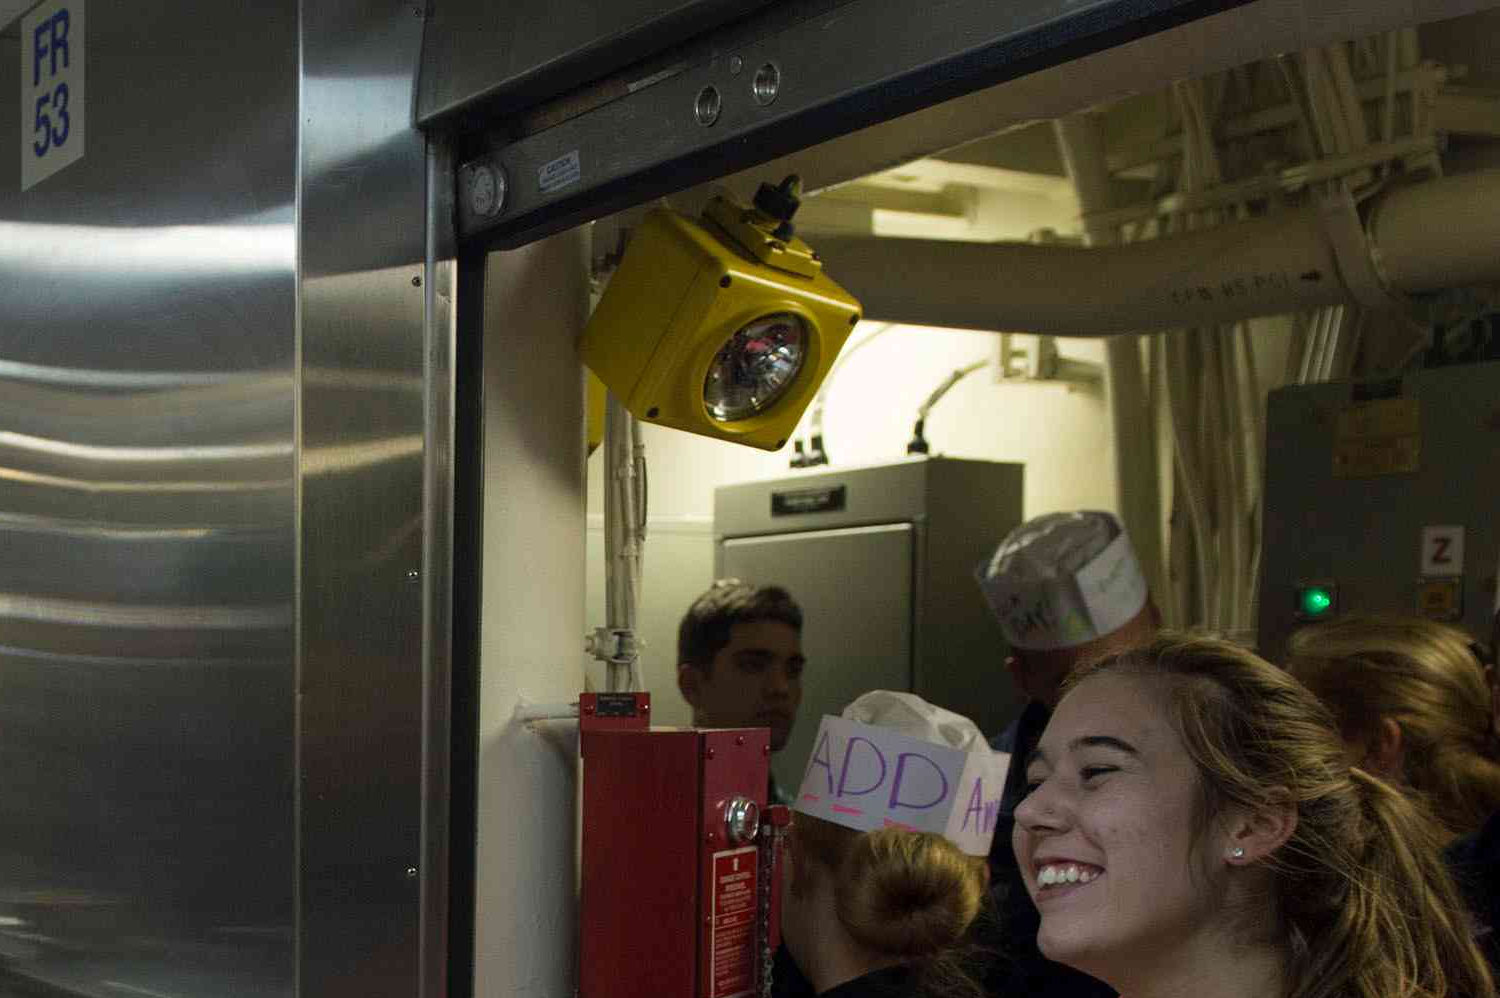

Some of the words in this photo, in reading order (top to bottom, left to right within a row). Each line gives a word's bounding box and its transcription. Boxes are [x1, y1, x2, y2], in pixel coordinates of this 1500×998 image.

[33, 7, 70, 87] FR
[33, 82, 70, 157] 53
[1431, 538, 1451, 564] Z
[807, 730, 949, 809] ADD
